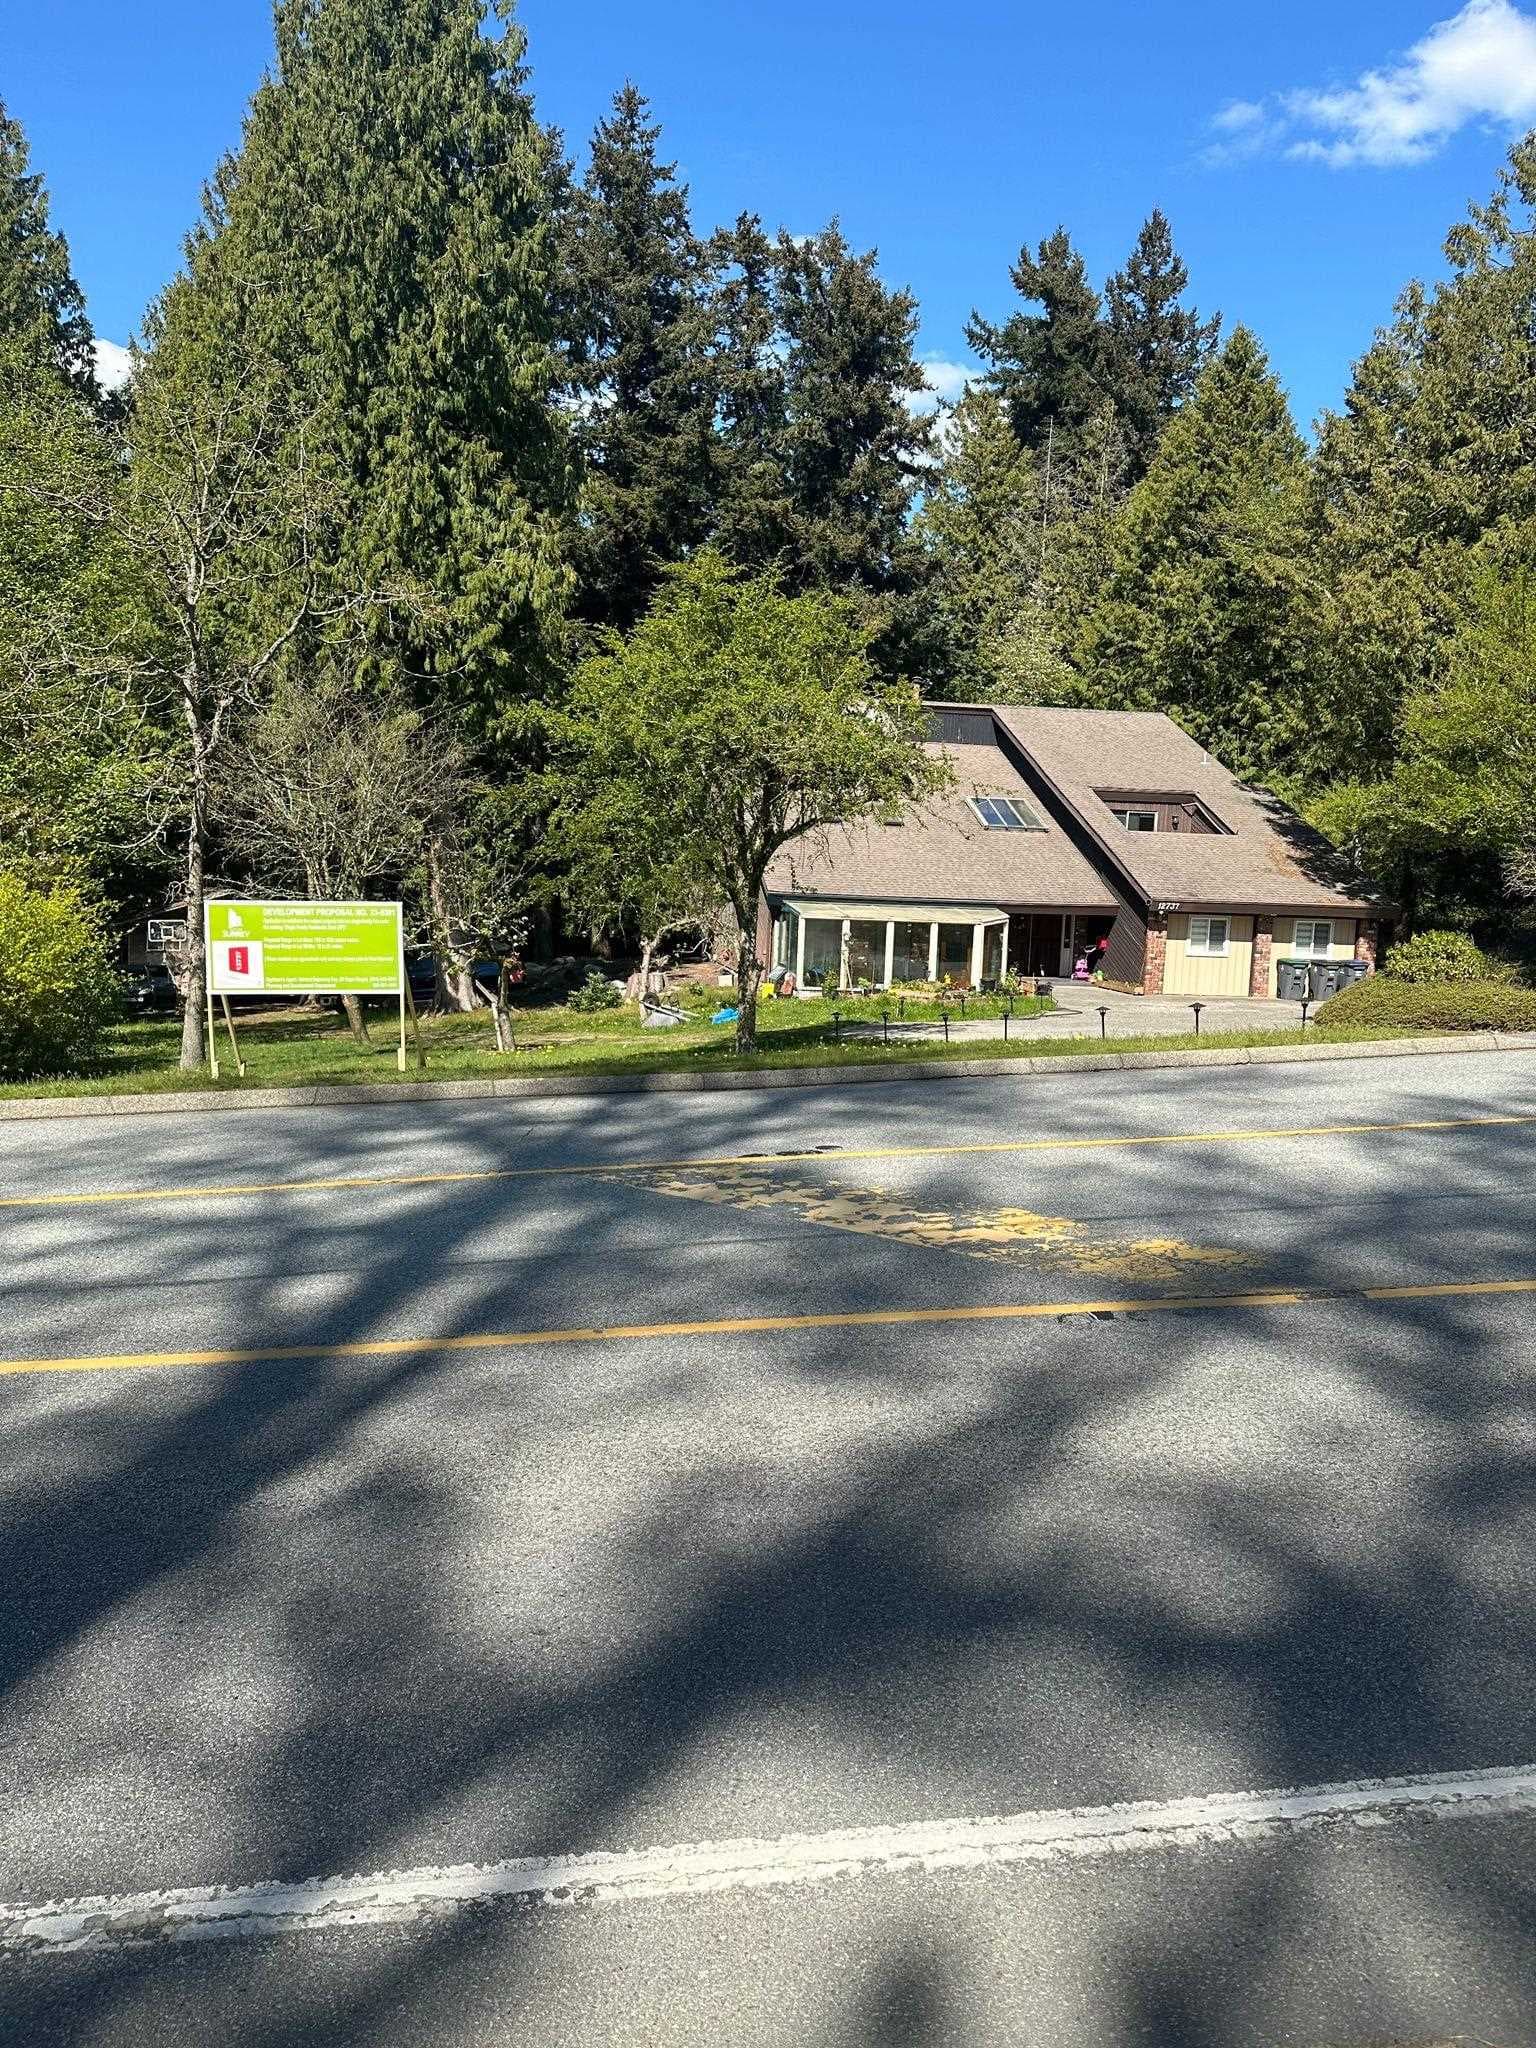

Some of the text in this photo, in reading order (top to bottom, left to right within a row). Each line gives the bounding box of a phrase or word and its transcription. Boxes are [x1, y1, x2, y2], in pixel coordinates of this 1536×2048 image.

[1158, 902, 1180, 910] 12737
[262, 907, 313, 917] DEVELOPMENT
[316, 907, 353, 917] PROPOSAL
